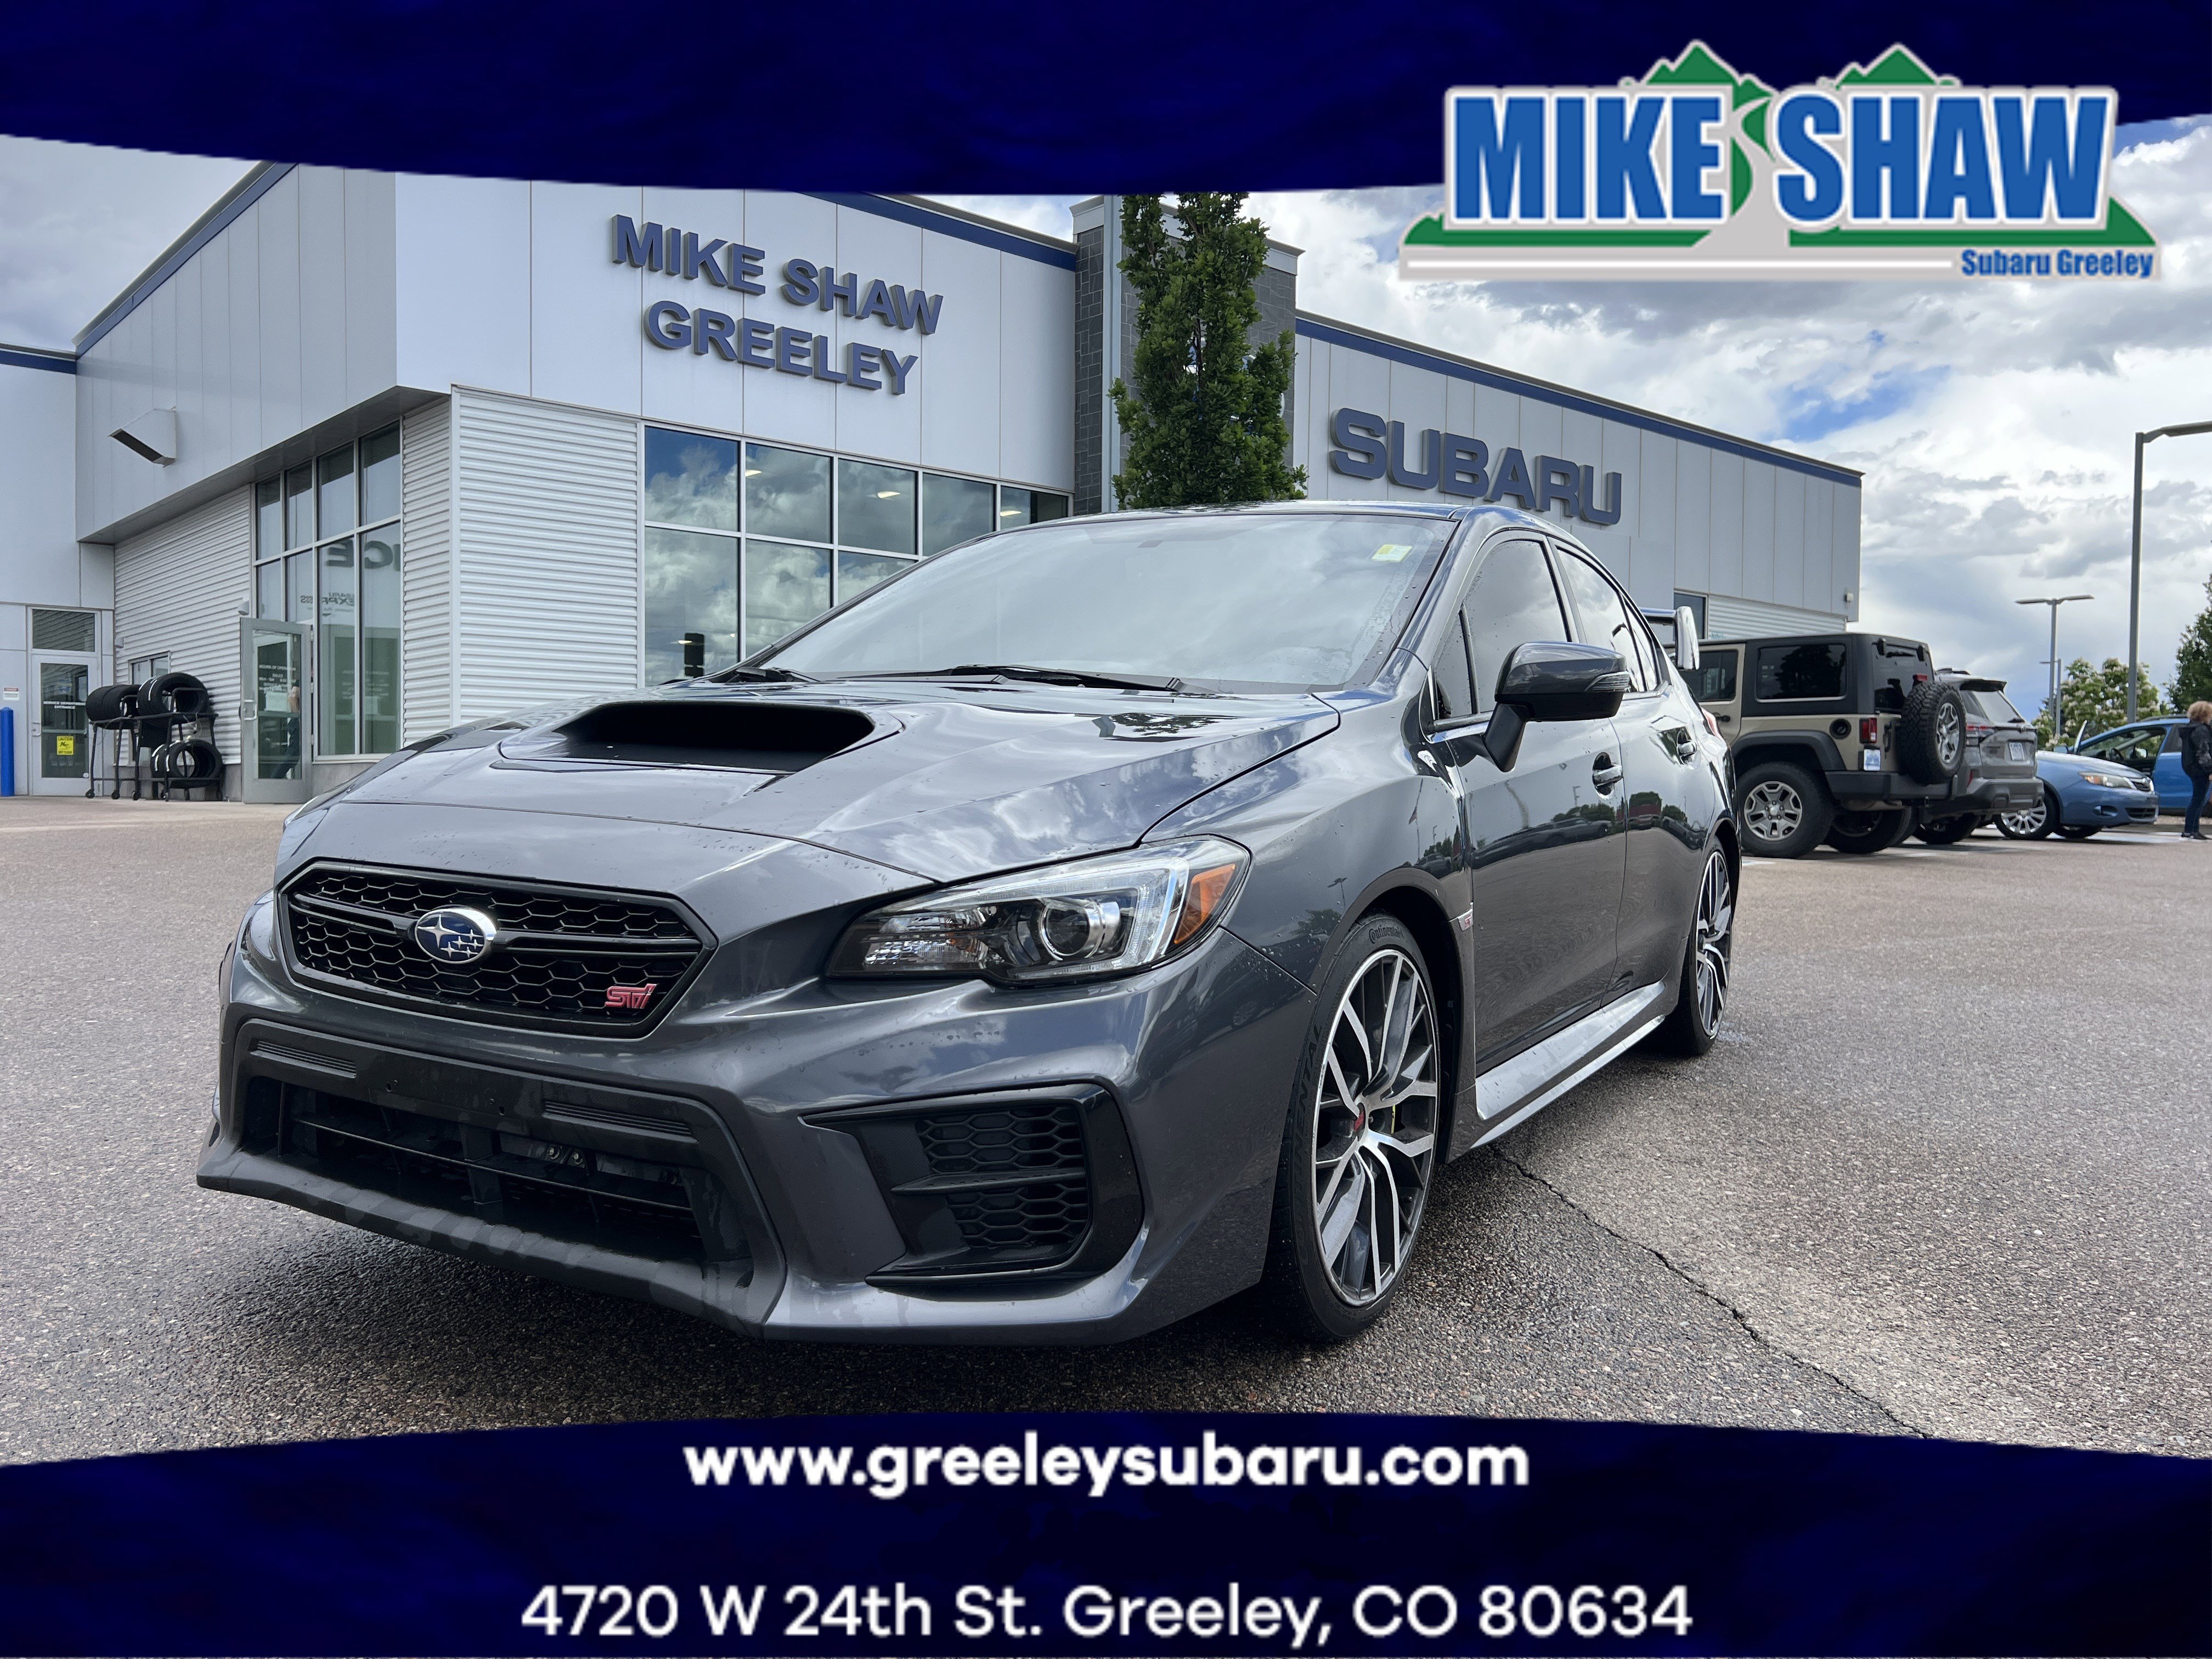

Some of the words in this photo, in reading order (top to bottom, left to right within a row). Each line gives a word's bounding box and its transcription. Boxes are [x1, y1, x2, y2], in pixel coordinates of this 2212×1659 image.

[612, 214, 765, 295] MIKE
[781, 258, 944, 335] SHAW
[644, 300, 919, 396] GREELEY
[1329, 408, 1622, 526] SUBARU
